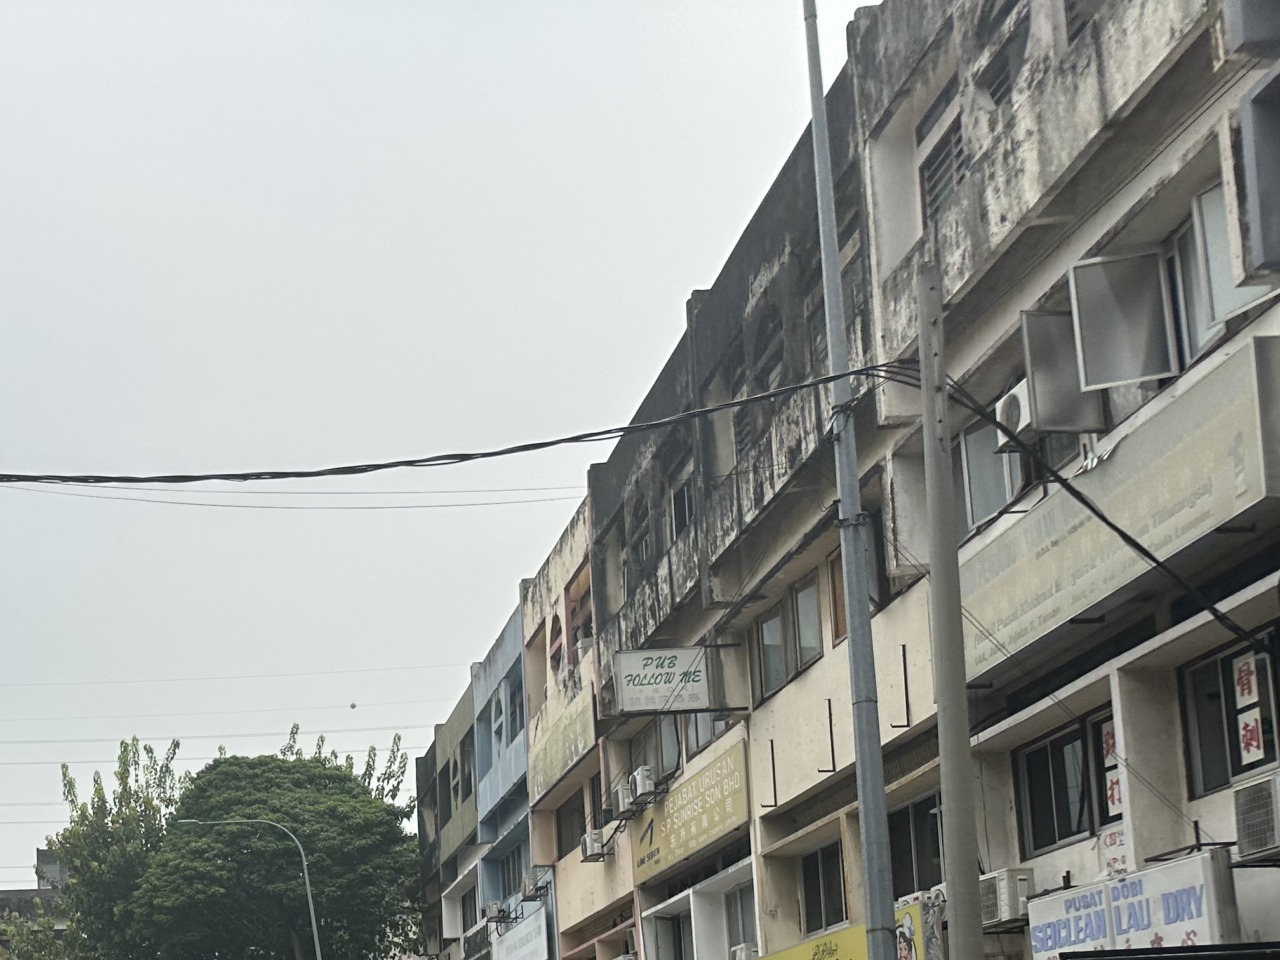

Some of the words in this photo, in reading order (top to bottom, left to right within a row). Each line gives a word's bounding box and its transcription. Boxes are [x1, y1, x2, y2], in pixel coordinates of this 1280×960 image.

[624, 672, 675, 686] FOLLOW
[679, 670, 701, 683] ME
[642, 655, 677, 669] PUB
[664, 781, 696, 816] PEJABAT
[700, 755, 734, 793] URUSAN
[673, 797, 702, 829] SUNRISE
[723, 772, 739, 796] BHD
[1064, 889, 1103, 914] PUSAT
[1110, 879, 1144, 902] DOBI
[1161, 884, 1204, 925] DRY
